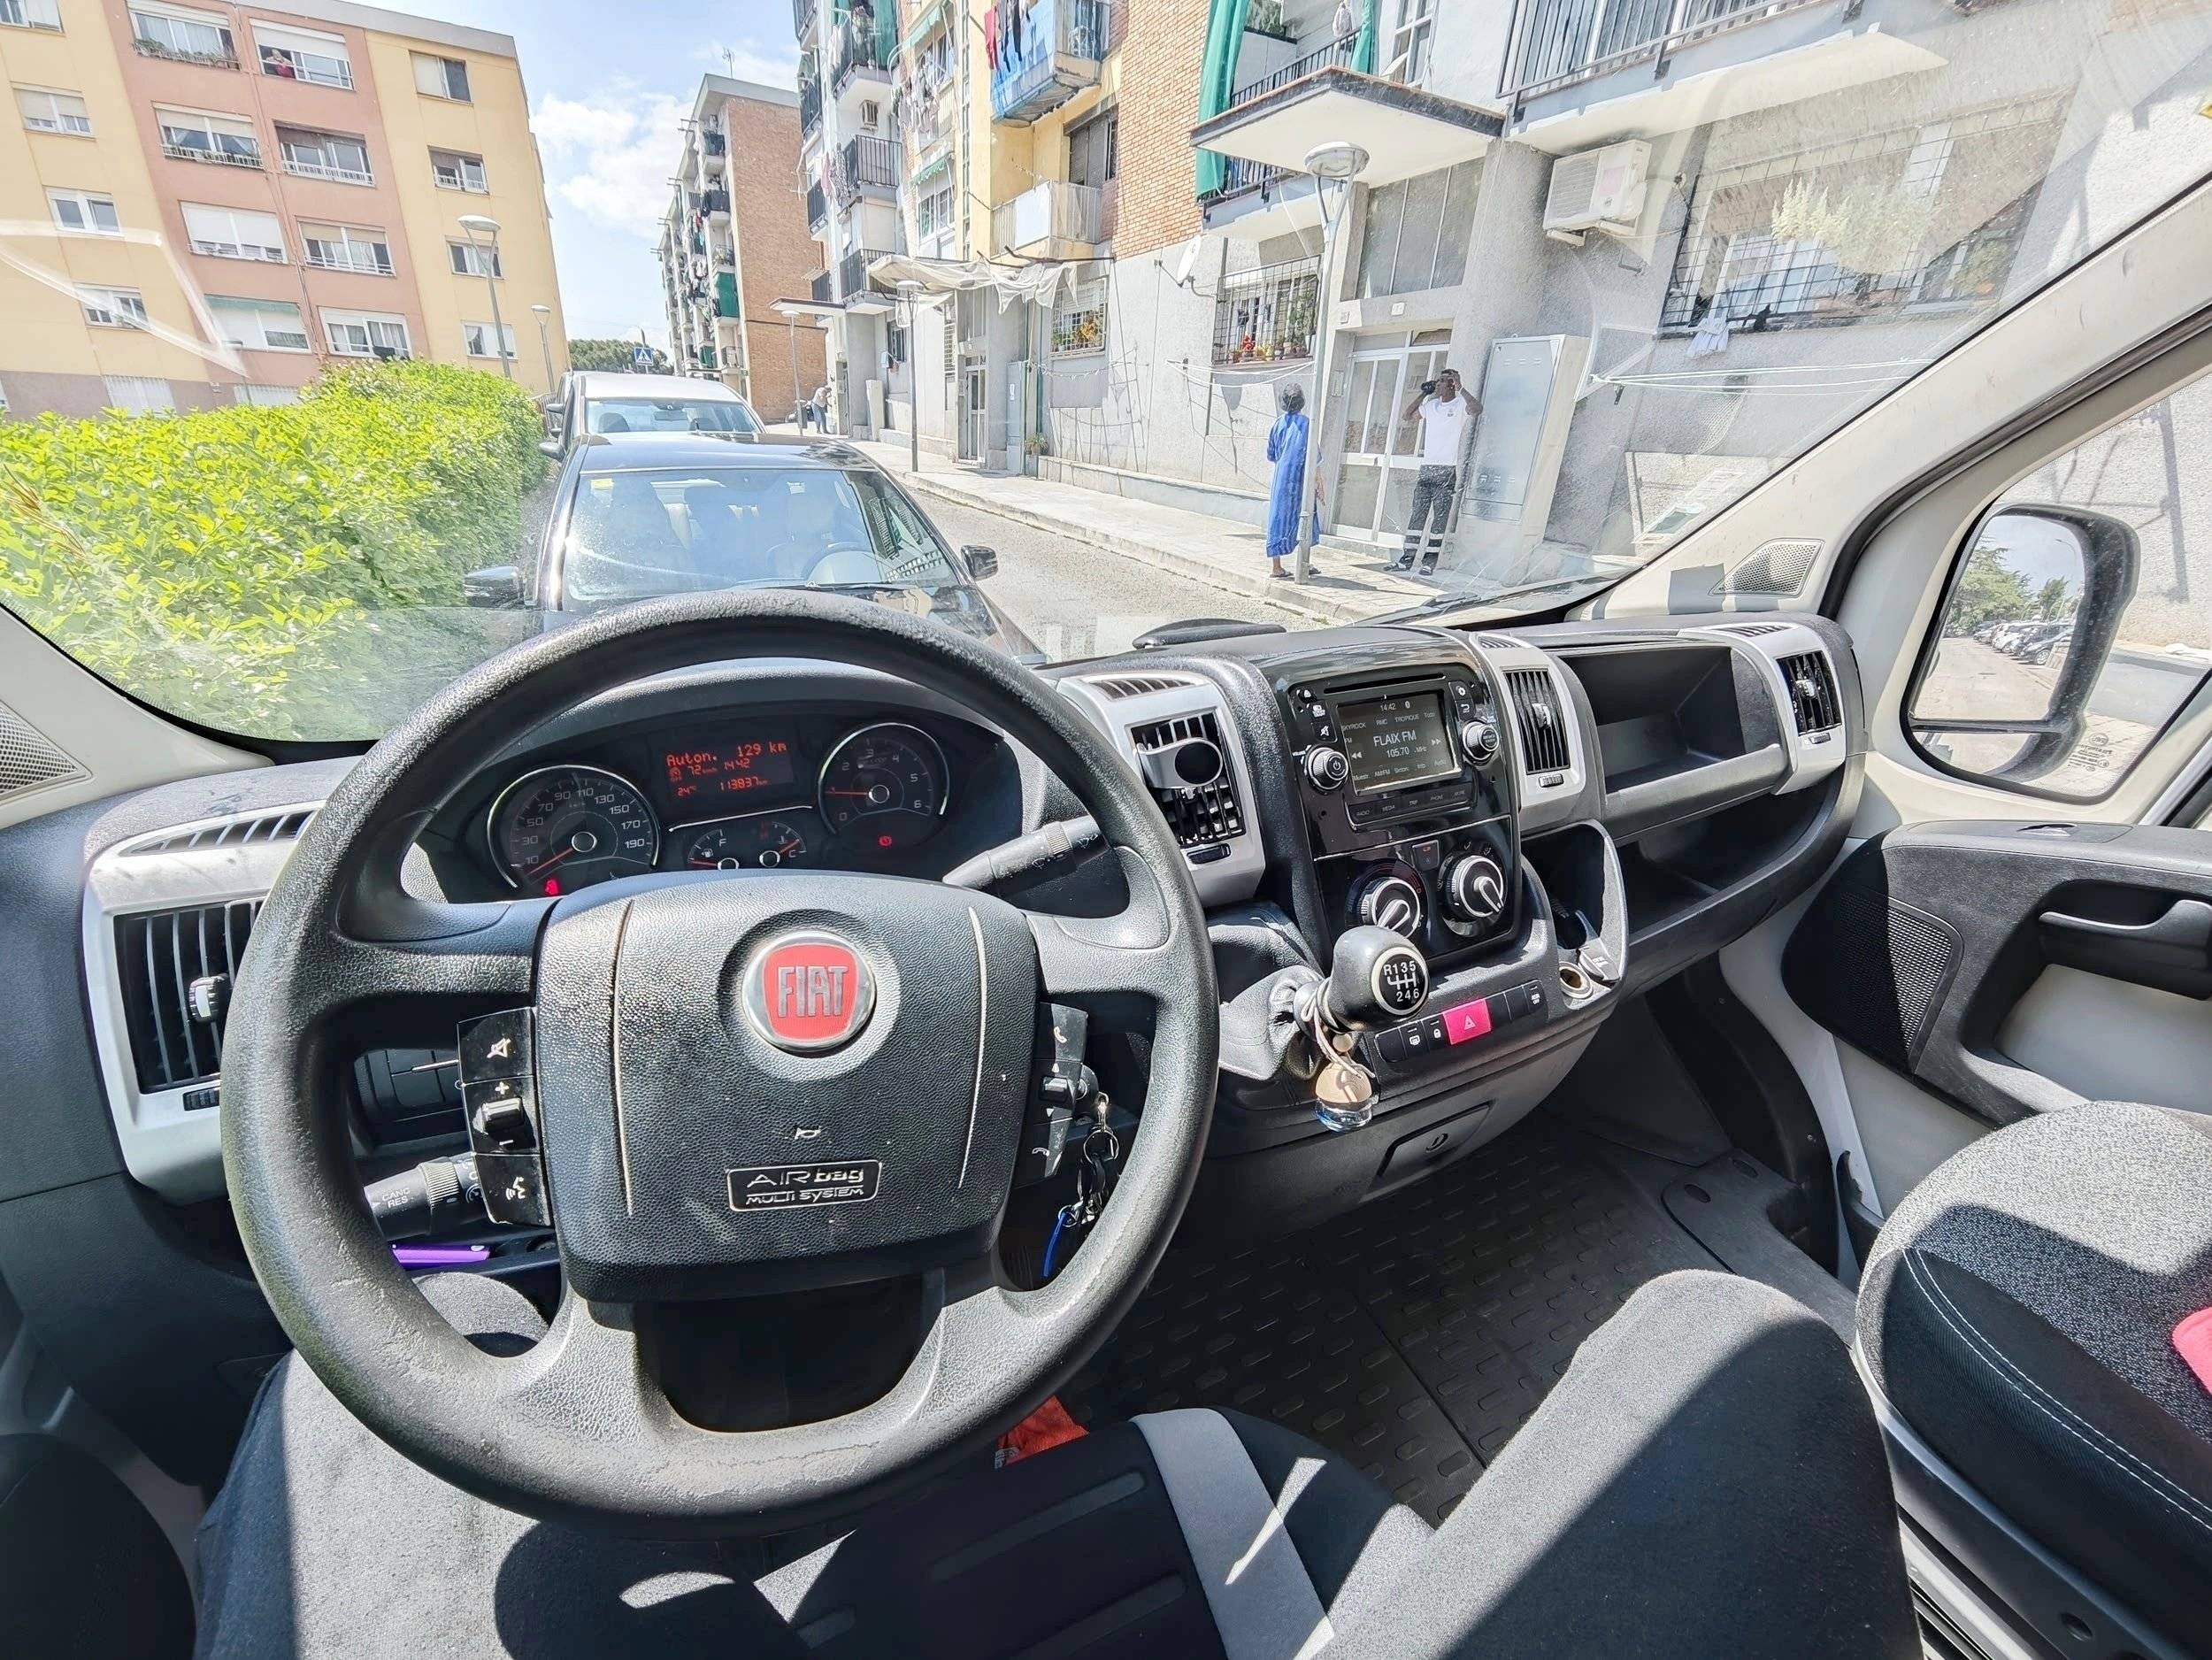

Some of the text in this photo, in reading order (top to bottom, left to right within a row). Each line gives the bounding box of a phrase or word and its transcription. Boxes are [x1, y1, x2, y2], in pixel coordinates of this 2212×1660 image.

[1373, 730, 1417, 746] FLAIX FM
[666, 742, 787, 766] Auton. 129 km
[1386, 747, 1409, 757] 105.70
[842, 762, 850, 771] 2
[910, 773, 918, 782] 5
[720, 776, 758, 790] 113837
[554, 791, 571, 801] 90
[595, 794, 615, 804] 130
[538, 802, 553, 812] 70
[609, 804, 629, 815] 150
[914, 800, 921, 809] 6
[526, 817, 544, 827] 50
[621, 819, 641, 830] 170
[522, 835, 539, 845] 30
[625, 838, 645, 849] 190
[719, 838, 726, 847] F
[525, 855, 539, 865] 10
[778, 965, 849, 1018] FIAT
[382, 1187, 411, 1202] CANC
[388, 1195, 409, 1209] RES
